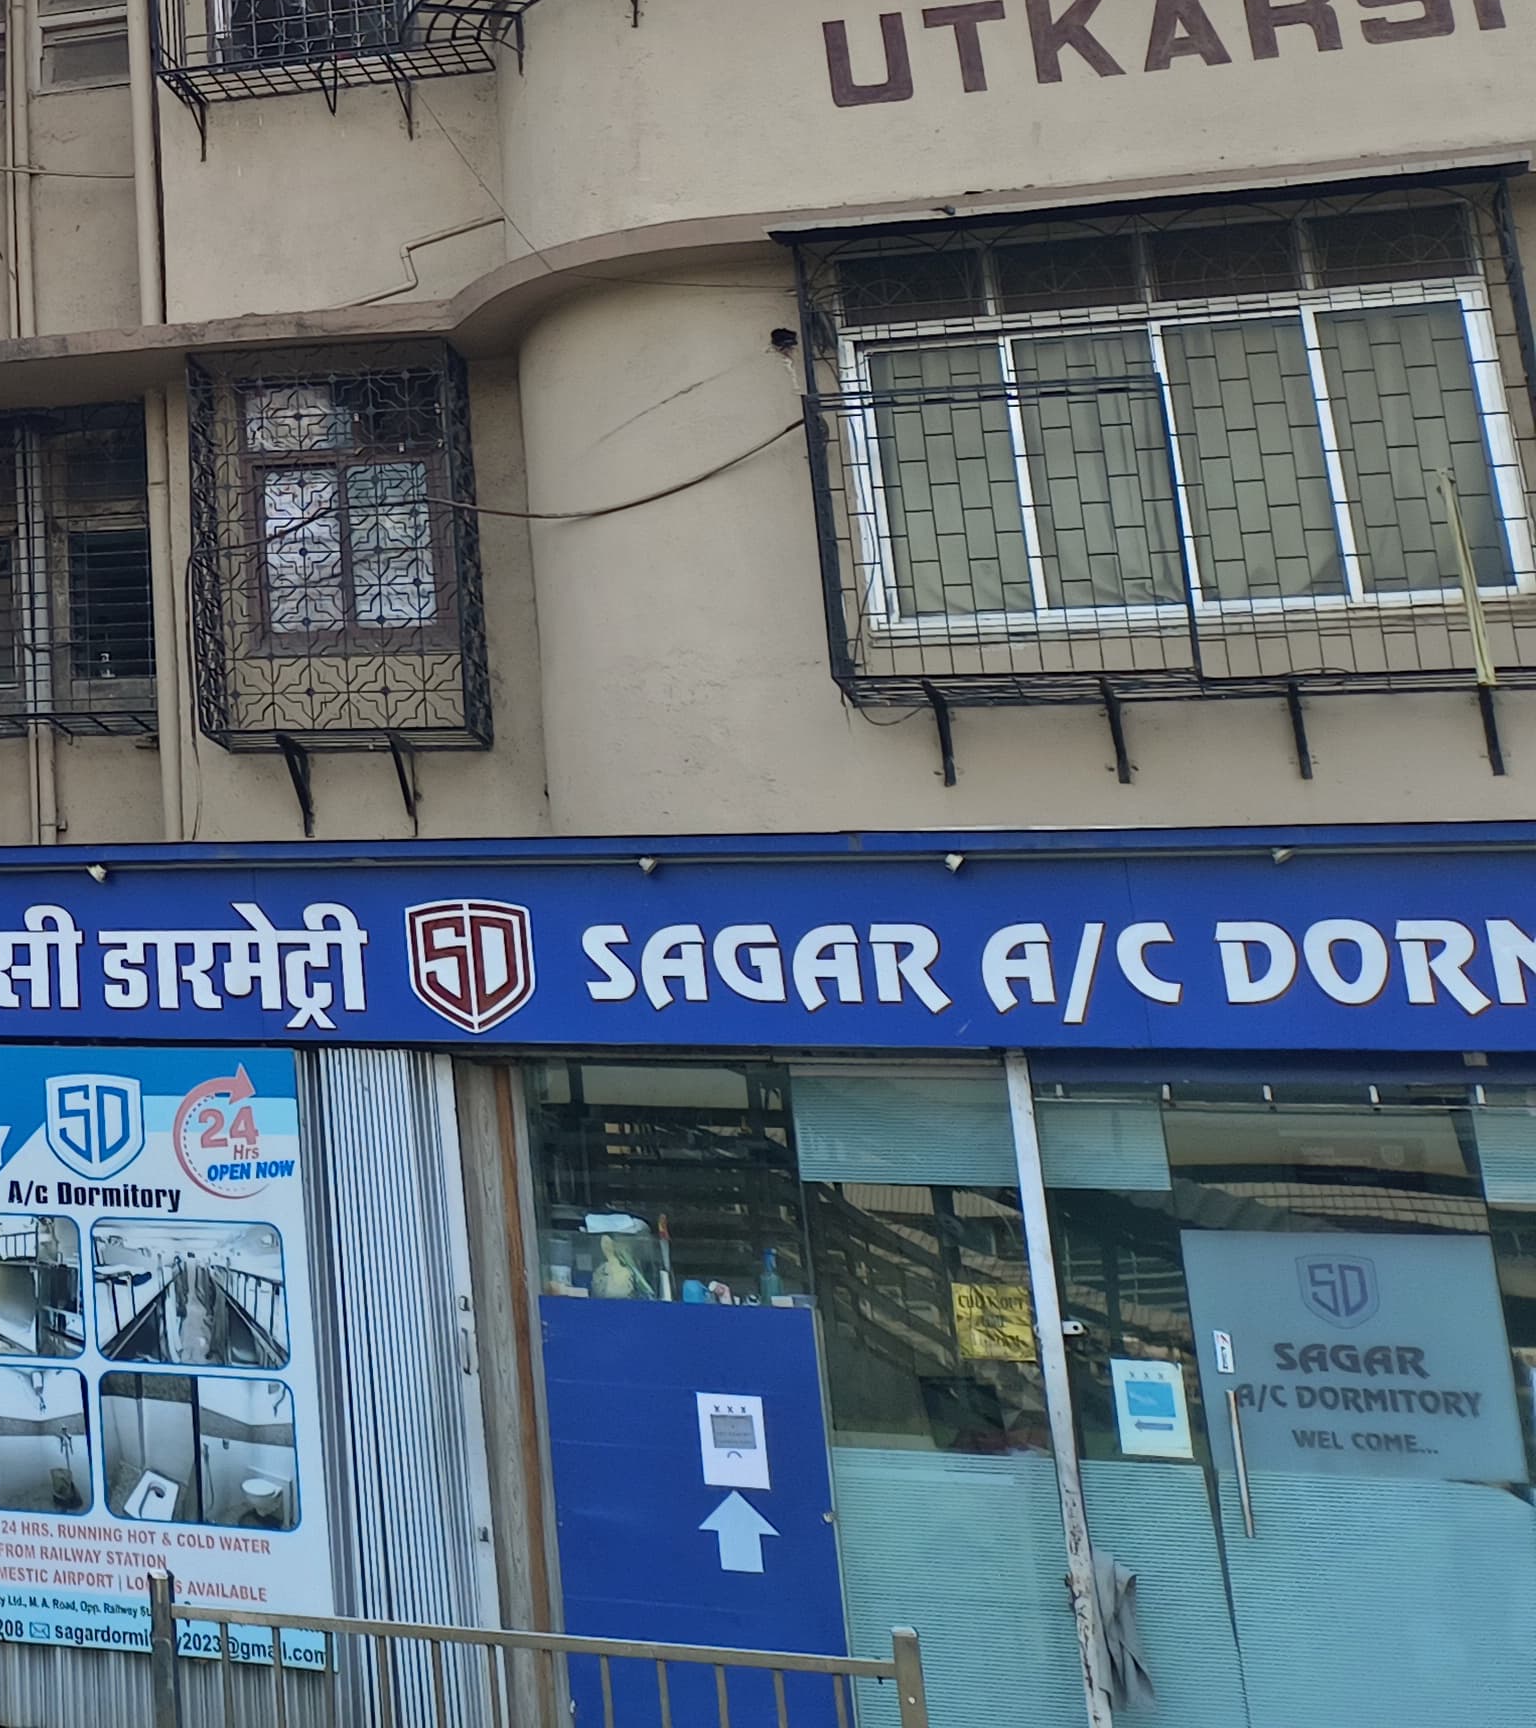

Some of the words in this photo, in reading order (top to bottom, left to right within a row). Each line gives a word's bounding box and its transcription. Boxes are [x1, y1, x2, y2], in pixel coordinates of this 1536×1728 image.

[581, 921, 952, 1015] SAGAR
[981, 920, 1183, 1025] A/C
[198, 1104, 260, 1150] 24
[232, 1142, 260, 1162] Hrs
[207, 1162, 249, 1183] OPEN
[254, 1160, 296, 1180] NOW
[58, 1182, 181, 1213] Dormitory
[1274, 1342, 1431, 1380] SAGAR
[1295, 1385, 1483, 1418] DORMITORY
[1292, 1430, 1344, 1451] WEL
[1, 1521, 17, 1535] 24
[21, 1522, 54, 1538] HRS.
[58, 1524, 123, 1543] RUNNING
[127, 1529, 157, 1545] HOT
[176, 1533, 215, 1550] COLD
[220, 1536, 271, 1555] WATER
[40, 1546, 101, 1564] RAILWAY
[106, 1550, 168, 1570] STATION
[53, 1570, 114, 1589] AIRPORT
[187, 1580, 268, 1603] AVAILABLE
